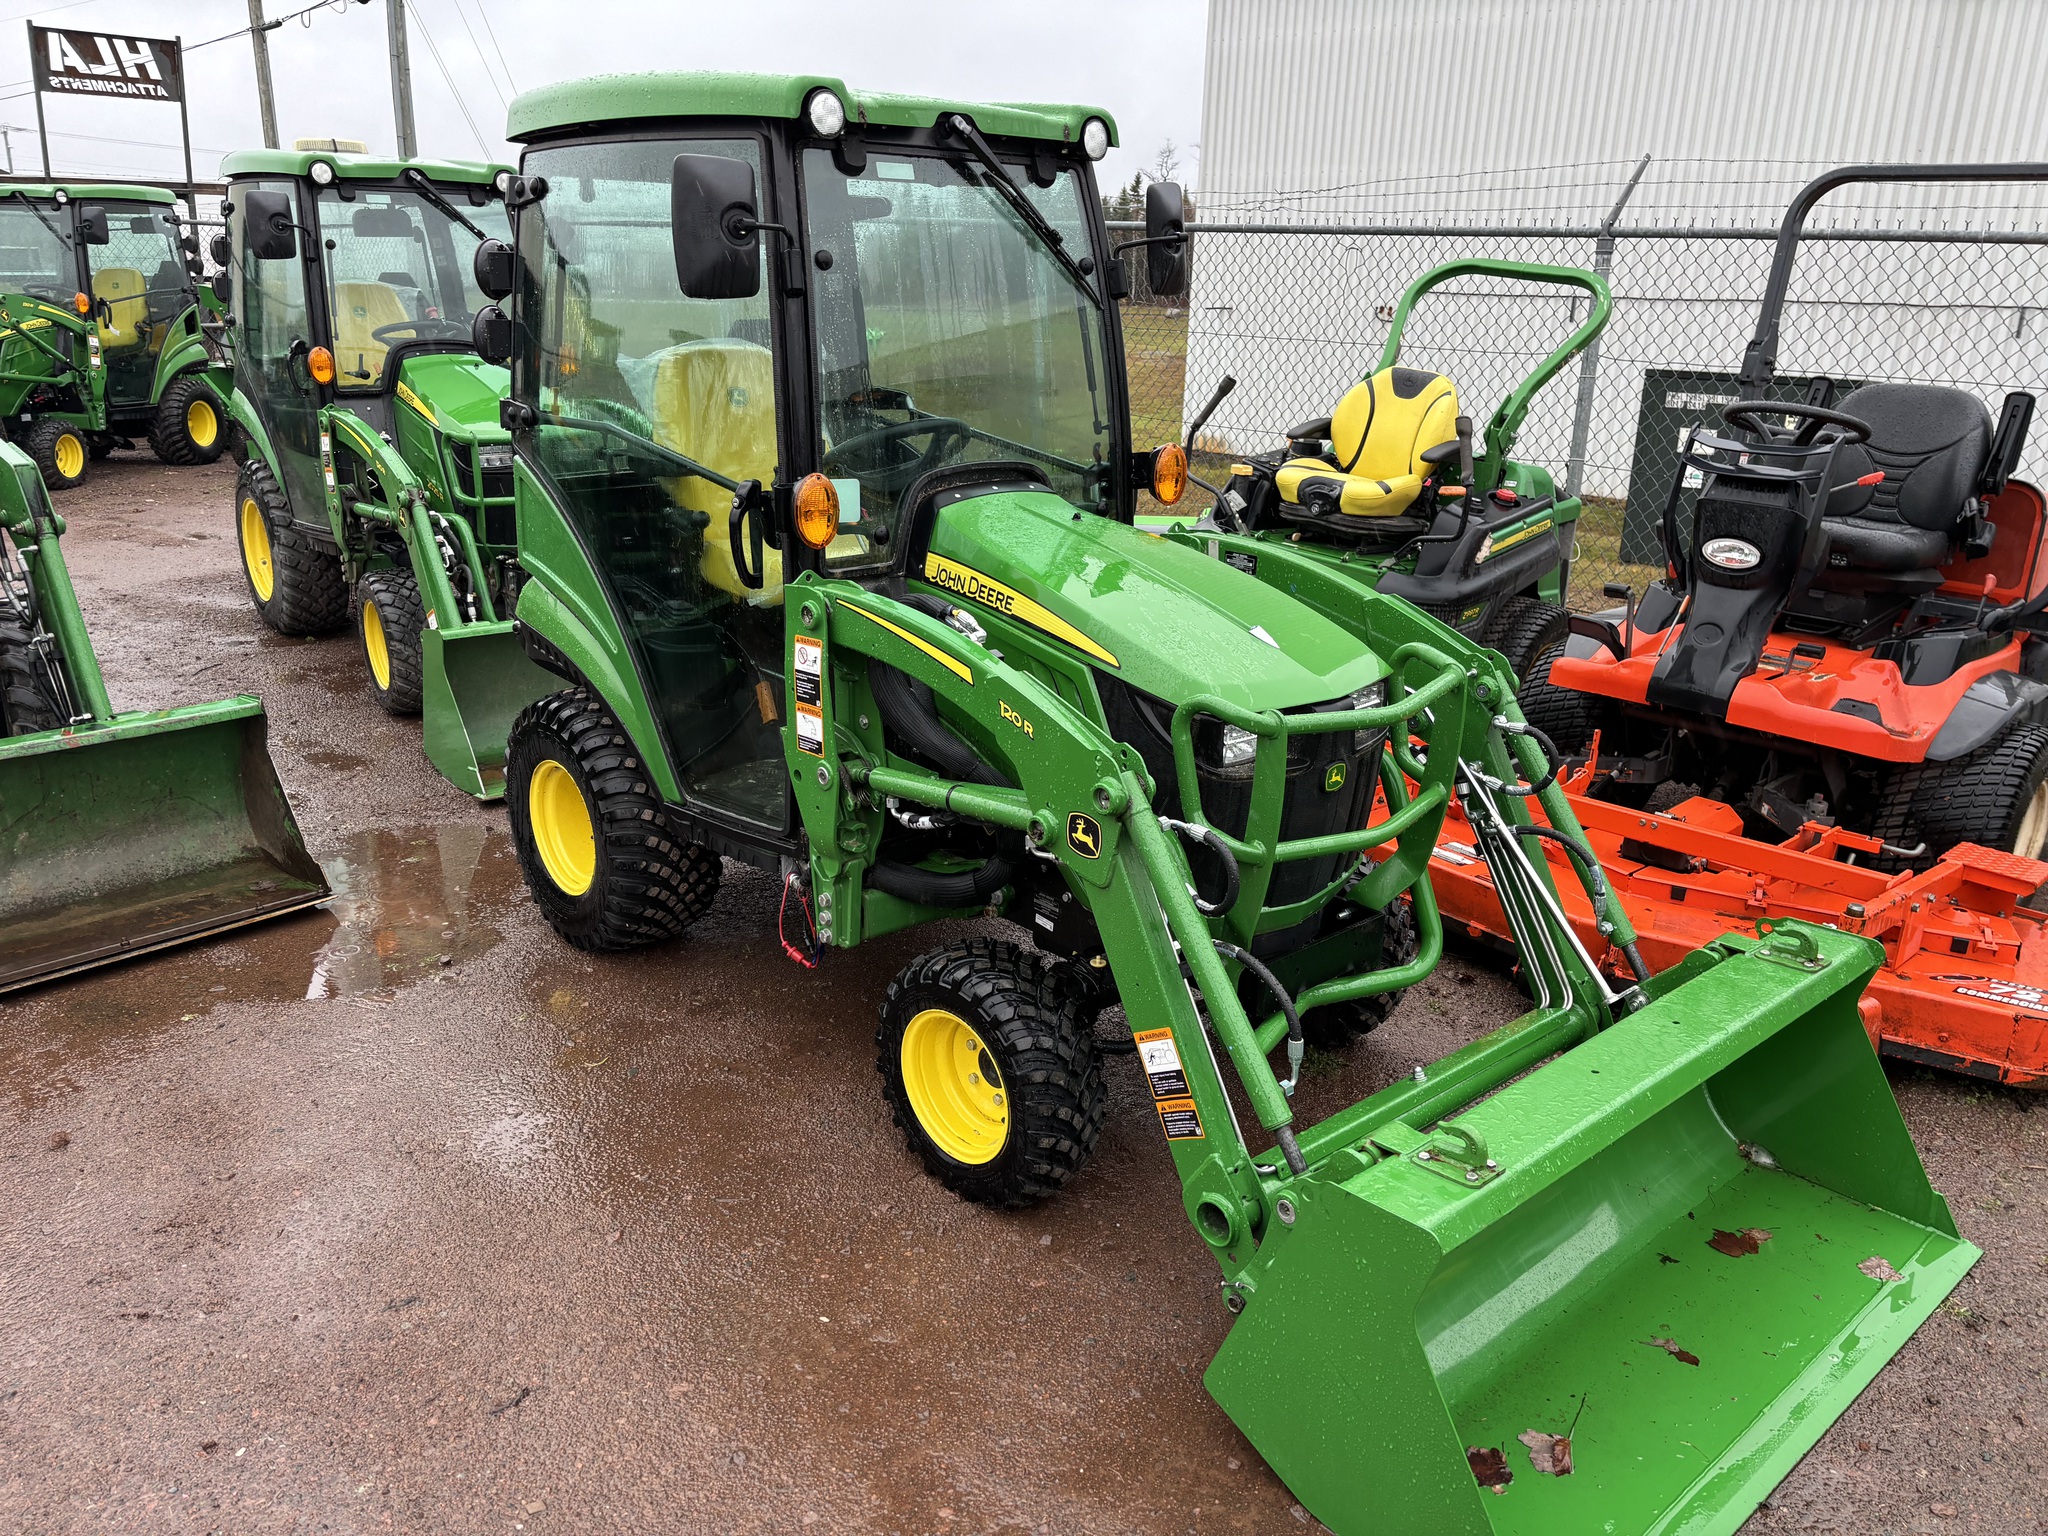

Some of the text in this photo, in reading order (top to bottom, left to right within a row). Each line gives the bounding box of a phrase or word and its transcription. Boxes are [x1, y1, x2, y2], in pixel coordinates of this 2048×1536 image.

[930, 563, 1015, 613] JOHN DEERE
[800, 637, 821, 648] WARNING
[800, 707, 821, 718] WARNING
[998, 699, 1034, 740] 120 R
[1987, 982, 2042, 1002] 72
[1144, 1030, 1169, 1040] WARNING
[1167, 1102, 1192, 1110] WARNING
